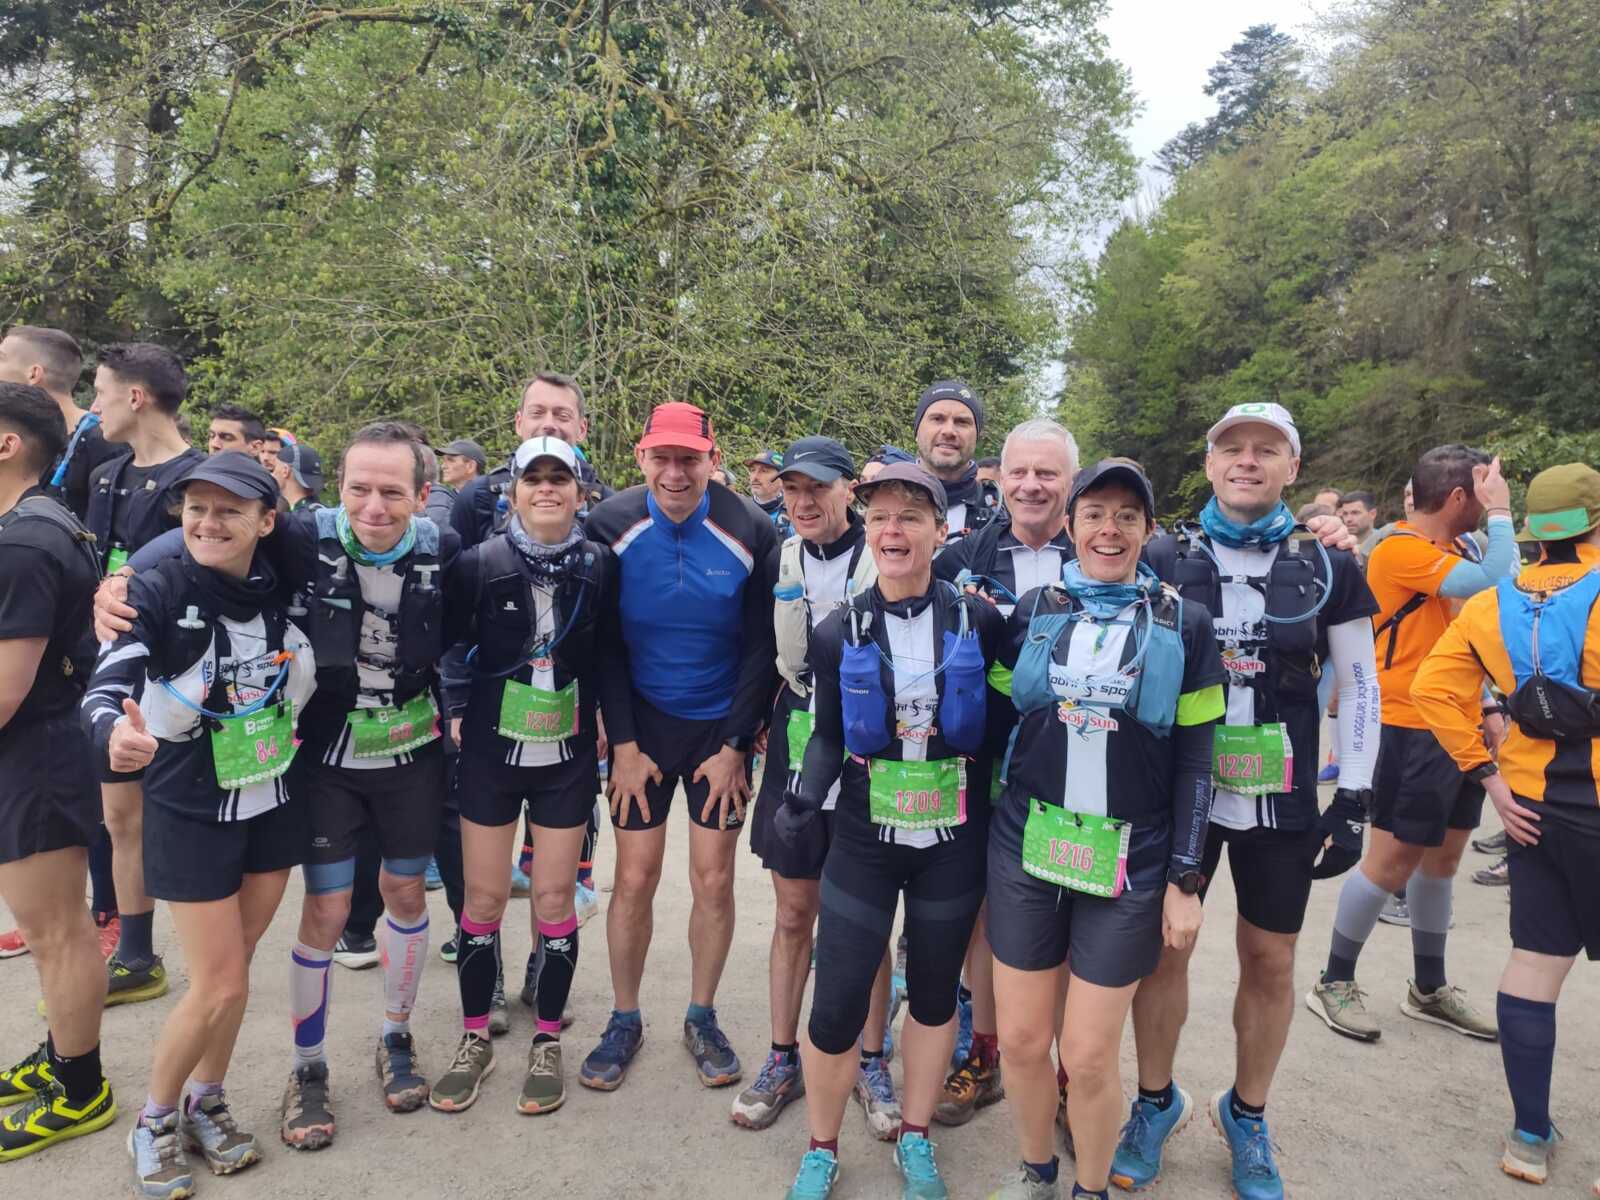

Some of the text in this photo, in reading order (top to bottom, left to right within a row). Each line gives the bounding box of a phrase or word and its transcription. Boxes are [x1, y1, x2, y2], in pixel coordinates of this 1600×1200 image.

[256, 736, 279, 764] 84
[1217, 752, 1263, 777] 1221
[896, 789, 941, 815] 1209
[1048, 838, 1094, 873] 1216
